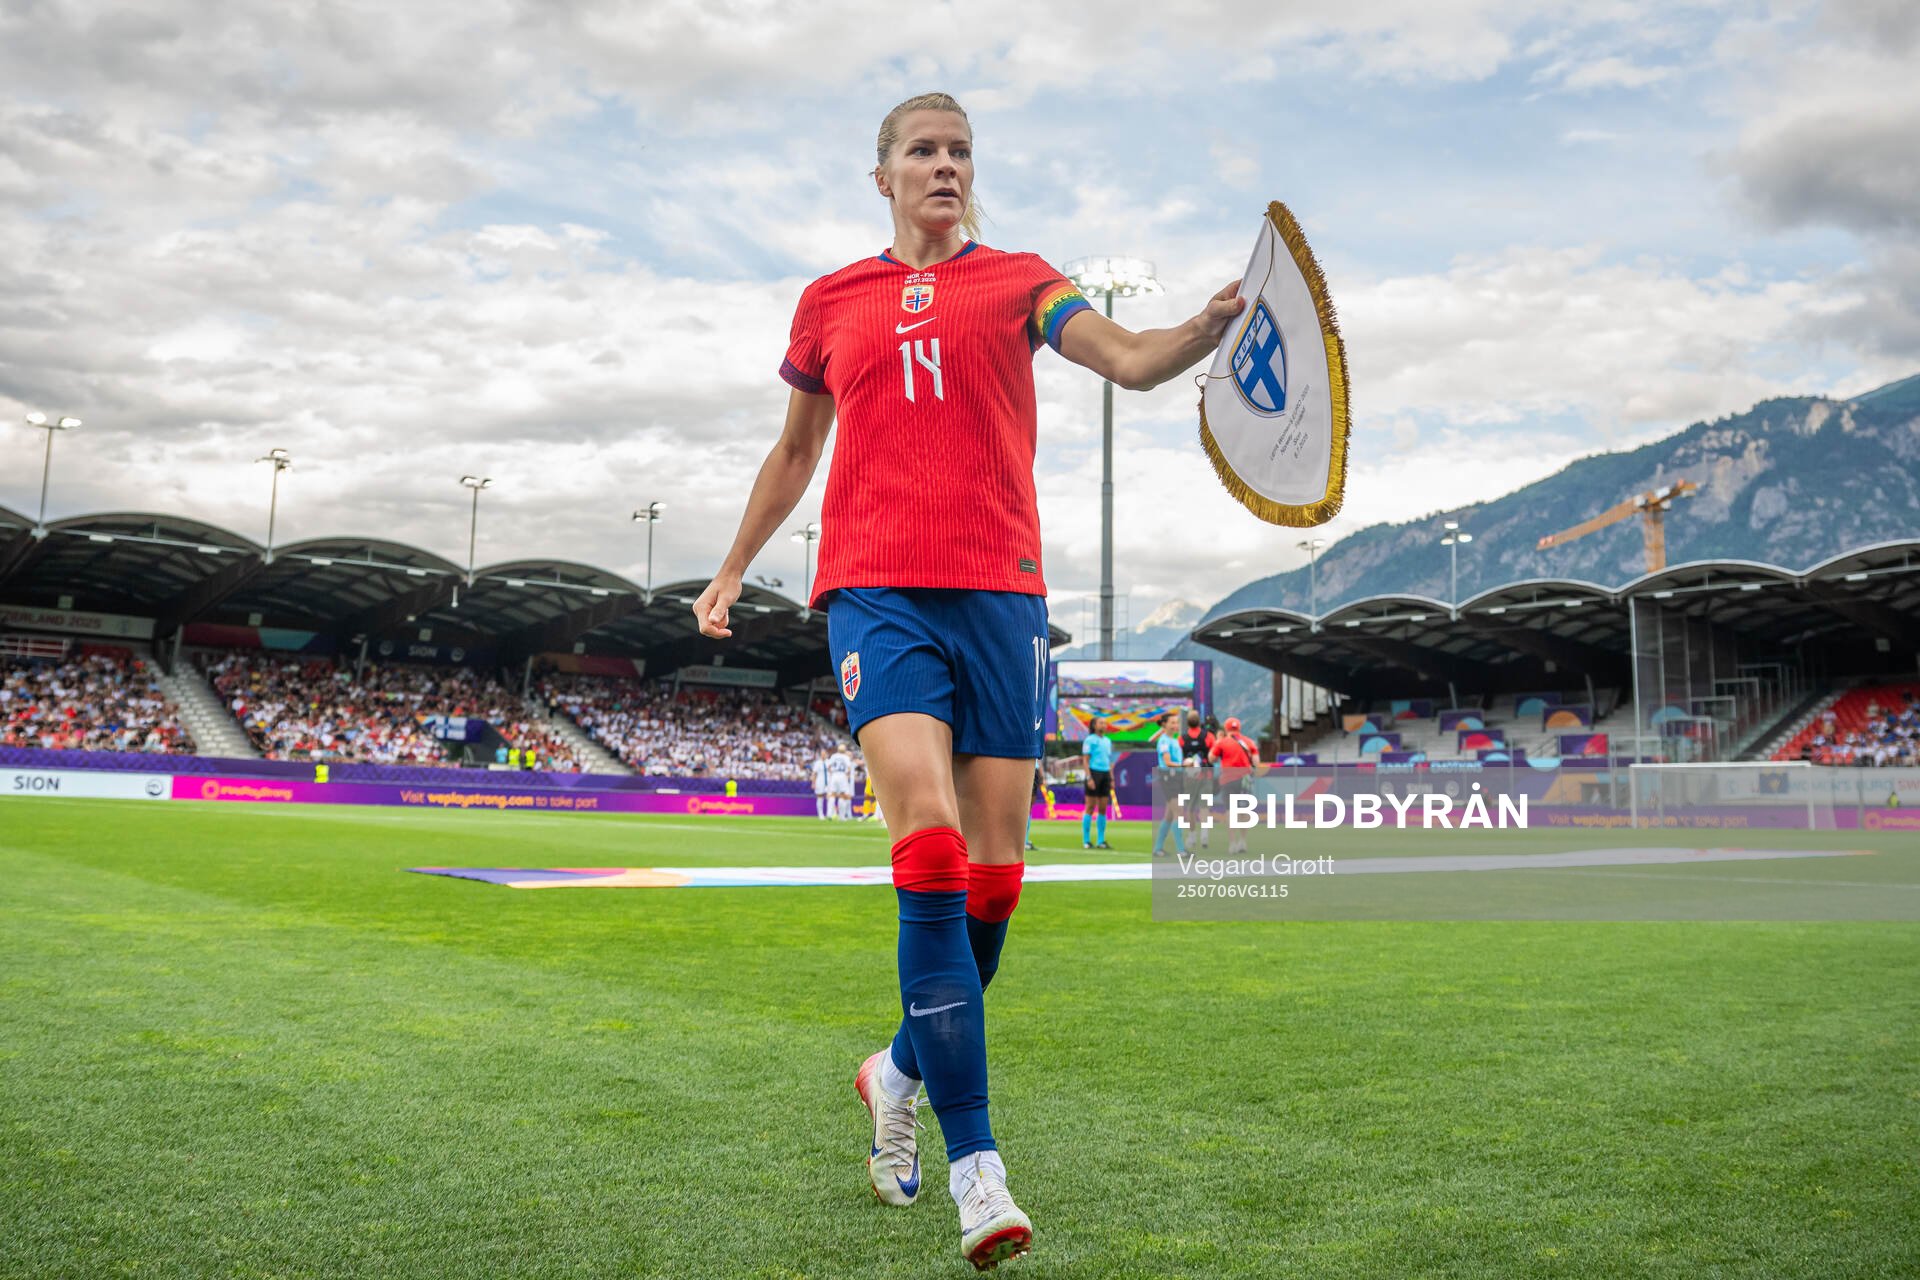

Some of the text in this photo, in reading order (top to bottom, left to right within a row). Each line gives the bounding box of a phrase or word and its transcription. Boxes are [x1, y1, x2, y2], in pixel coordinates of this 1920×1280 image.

[898, 338, 944, 403] 14
[13, 775, 60, 791] SION
[400, 790, 424, 803] Visit
[427, 792, 534, 809] weplaystrong.com
[535, 796, 547, 806] to
[550, 795, 573, 807] take
